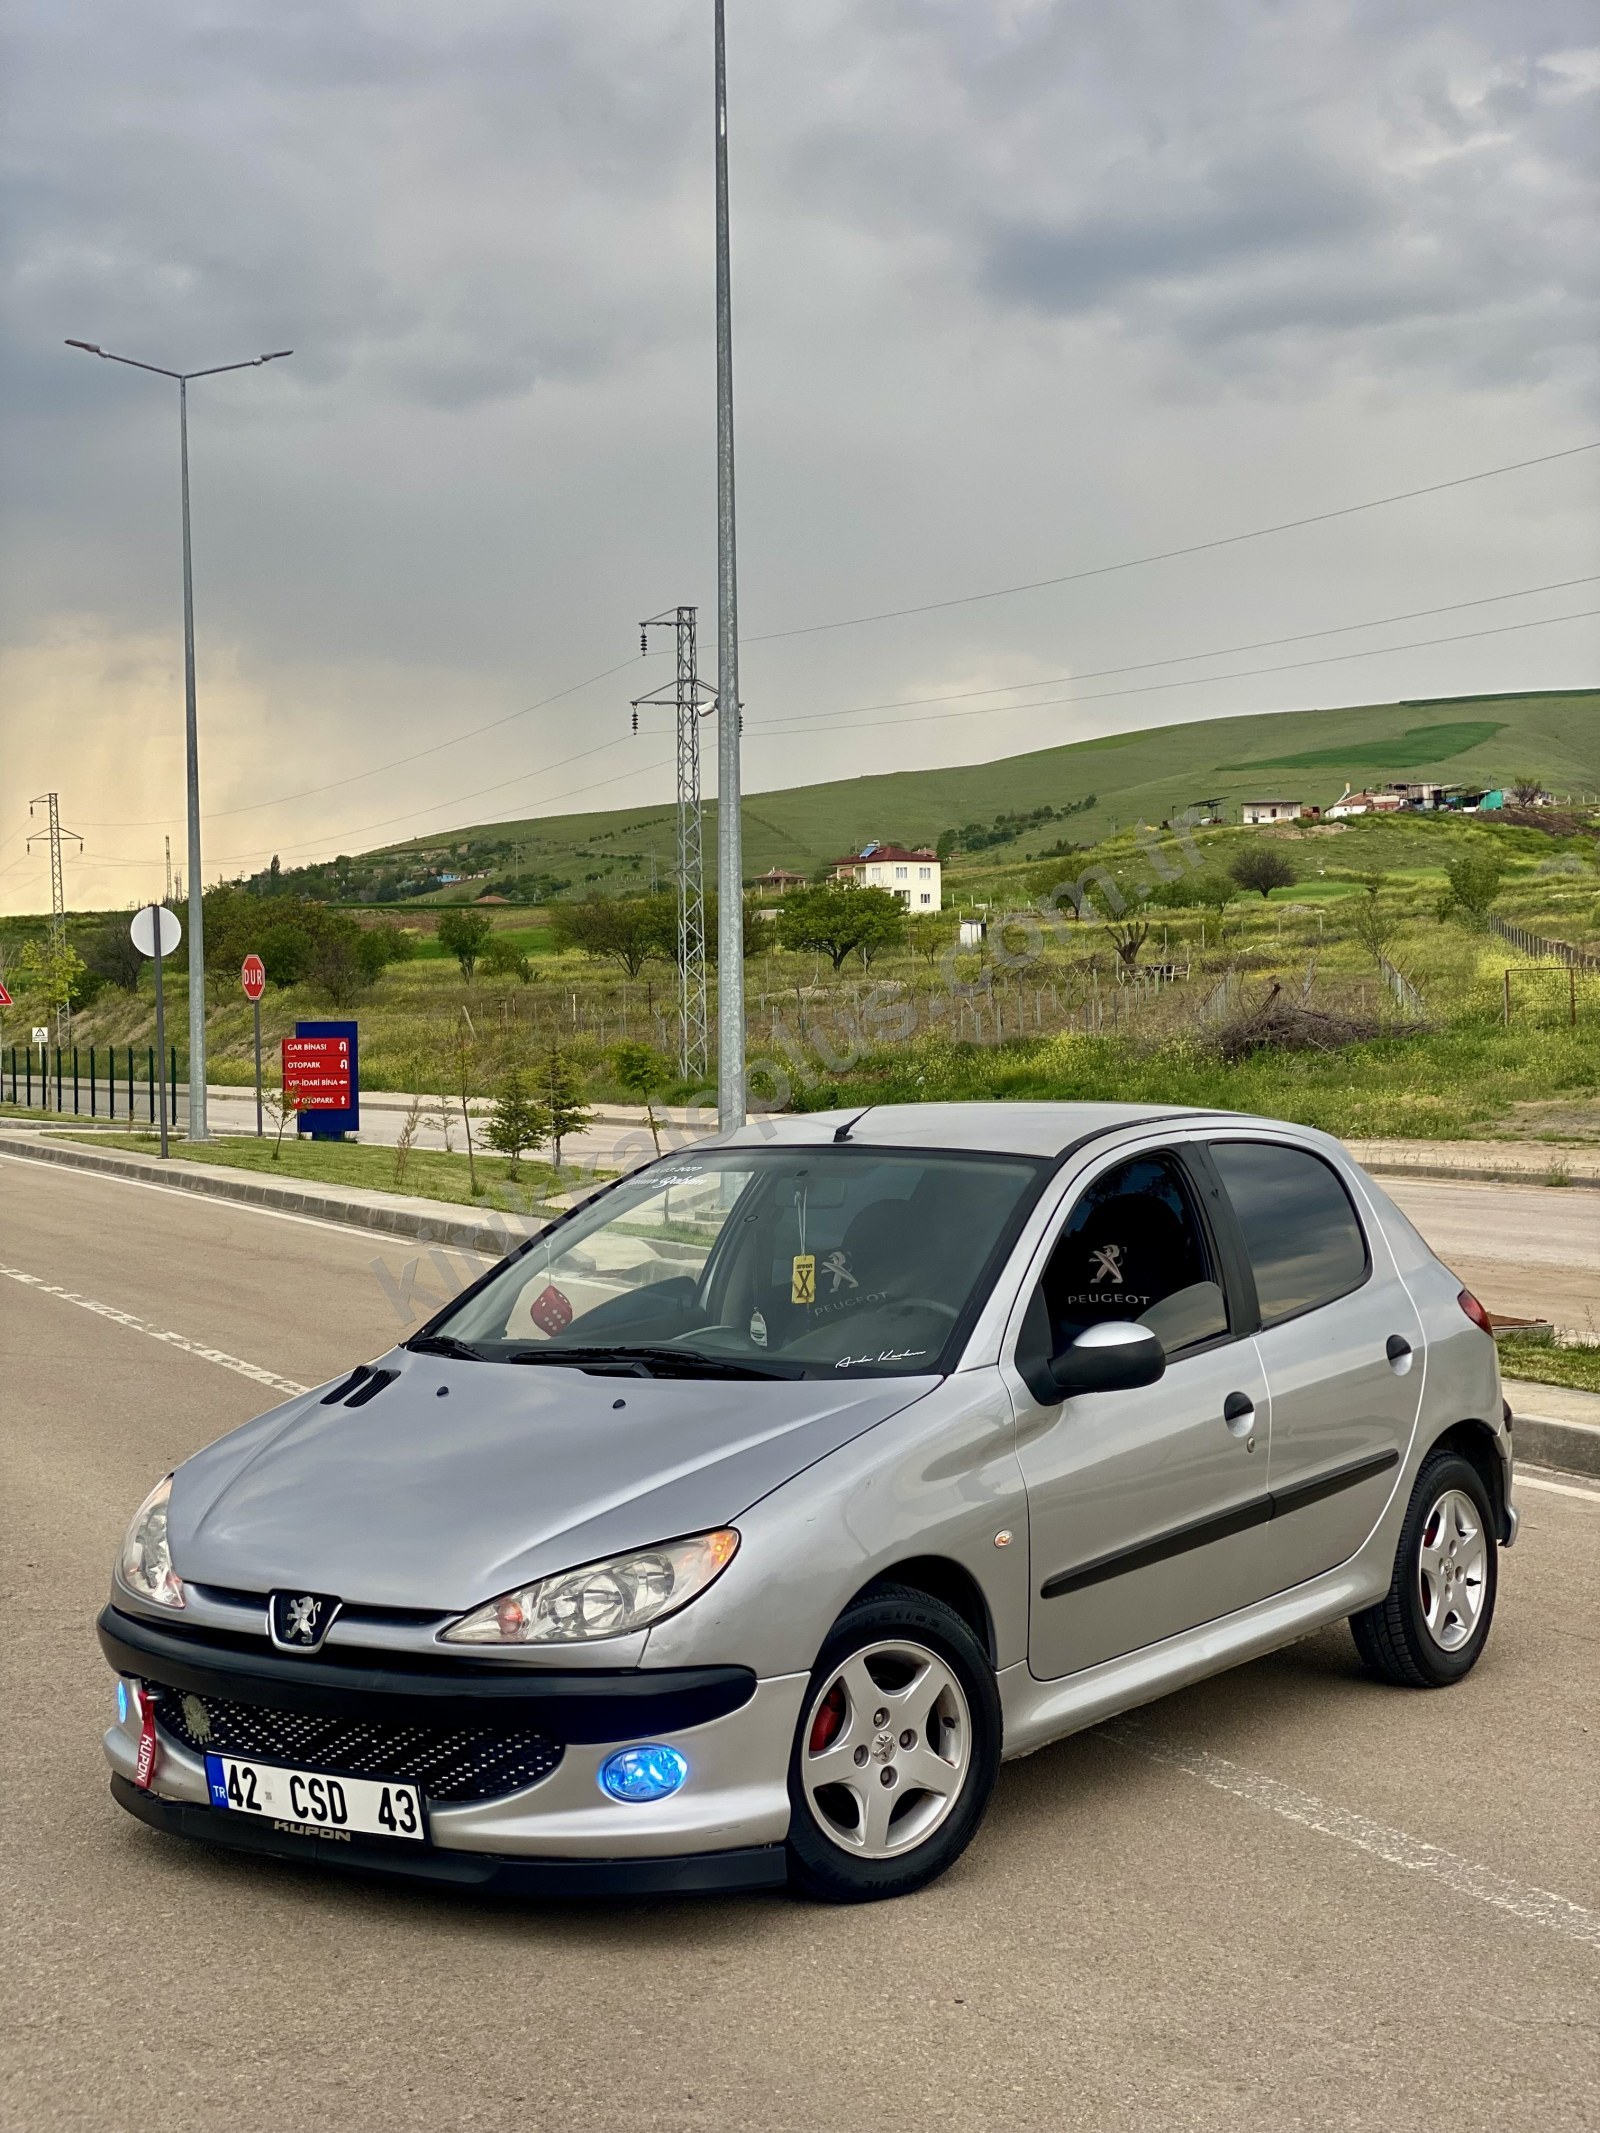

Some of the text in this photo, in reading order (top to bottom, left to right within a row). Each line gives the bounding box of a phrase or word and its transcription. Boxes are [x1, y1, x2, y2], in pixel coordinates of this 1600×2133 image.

[244, 969, 262, 985] DUR
[303, 1042, 327, 1051] BİNASI
[287, 1061, 321, 1069] OTOPARK
[321, 1078, 338, 1086] BİNA
[814, 1290, 888, 1317] PEUGEOT
[1068, 1293, 1151, 1305] PEUGEOT
[137, 1733, 153, 1783] KUPON
[212, 1764, 417, 1833] TR 42 CSD 43
[273, 1820, 351, 1842] KUPON
